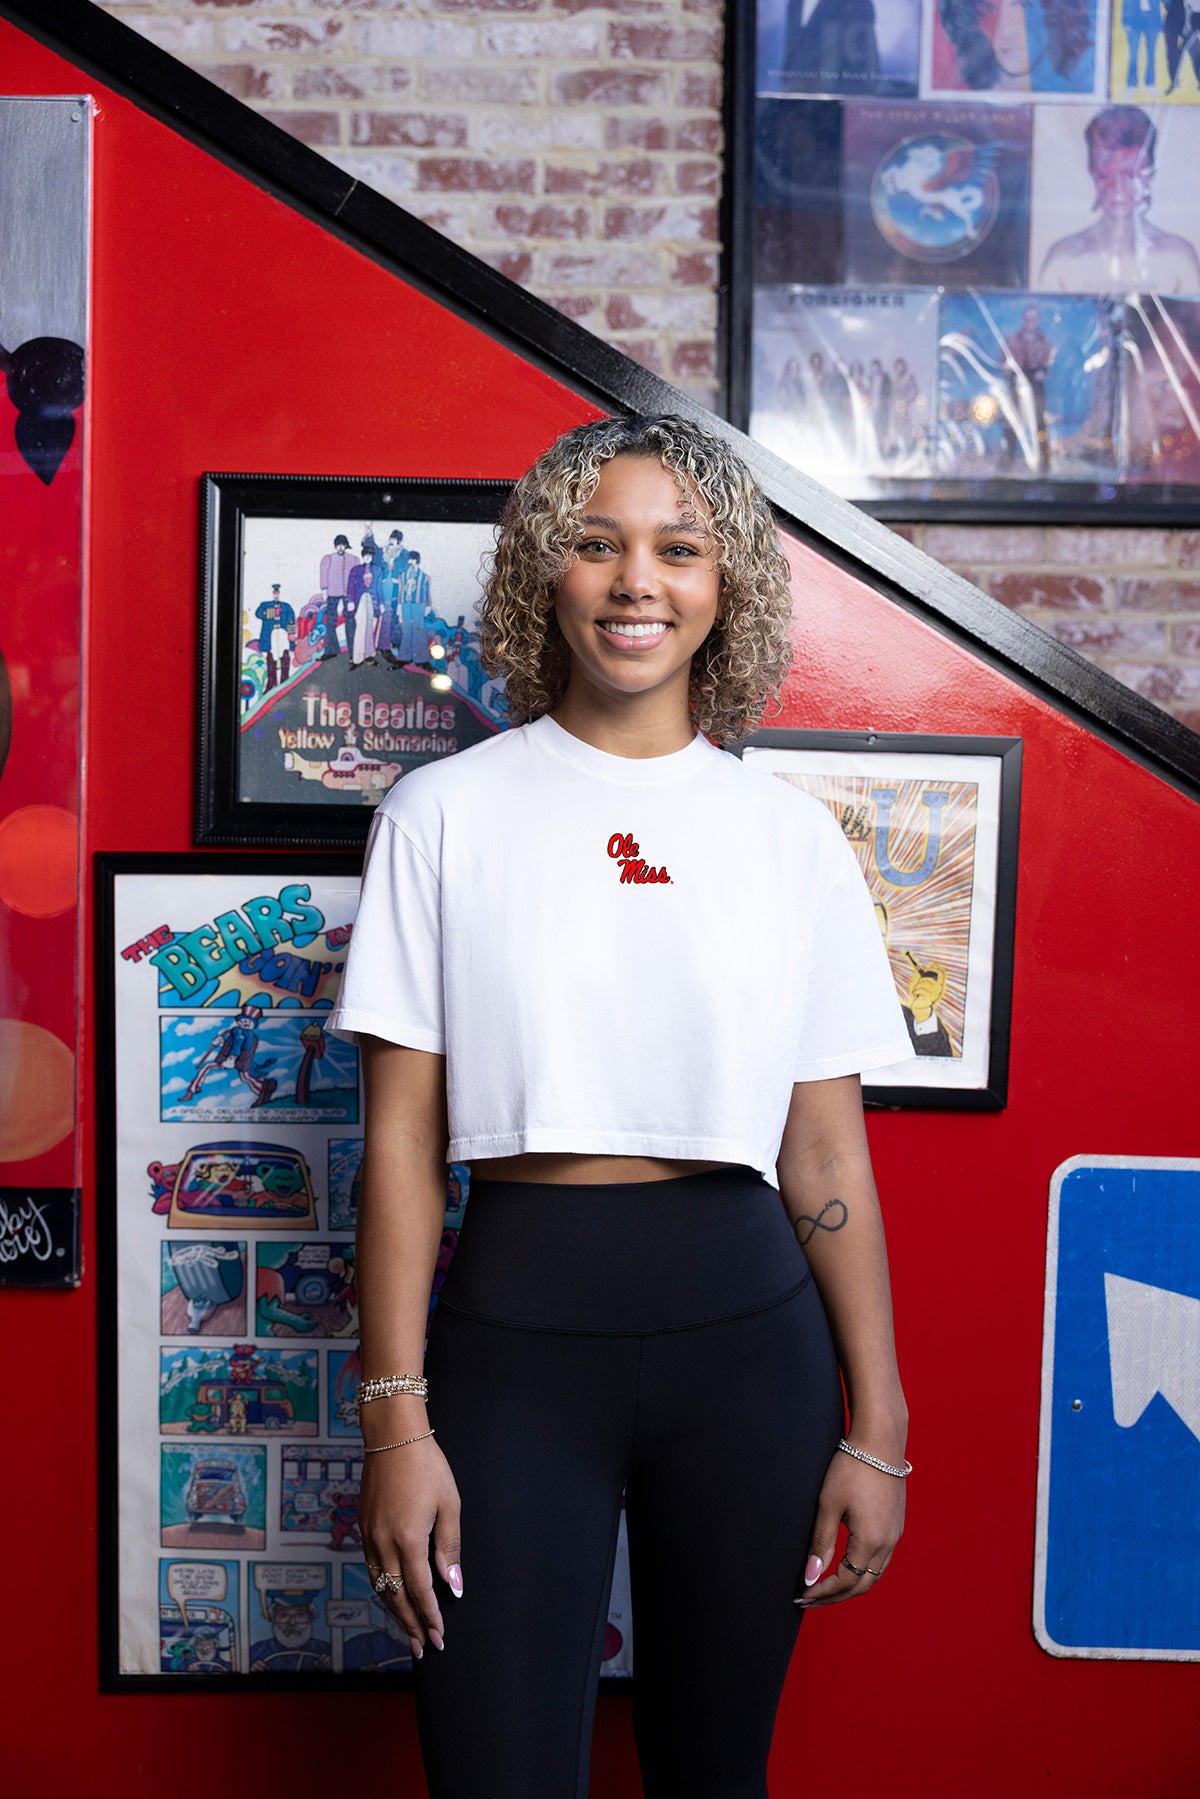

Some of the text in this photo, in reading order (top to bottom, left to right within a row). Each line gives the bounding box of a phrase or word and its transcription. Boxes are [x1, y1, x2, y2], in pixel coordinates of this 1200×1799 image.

[302, 692, 456, 730] The Beatles
[278, 726, 458, 753] Yellow Submarine
[607, 832, 640, 858] Ole
[121, 924, 175, 963] THE
[150, 883, 325, 1000] BEARS
